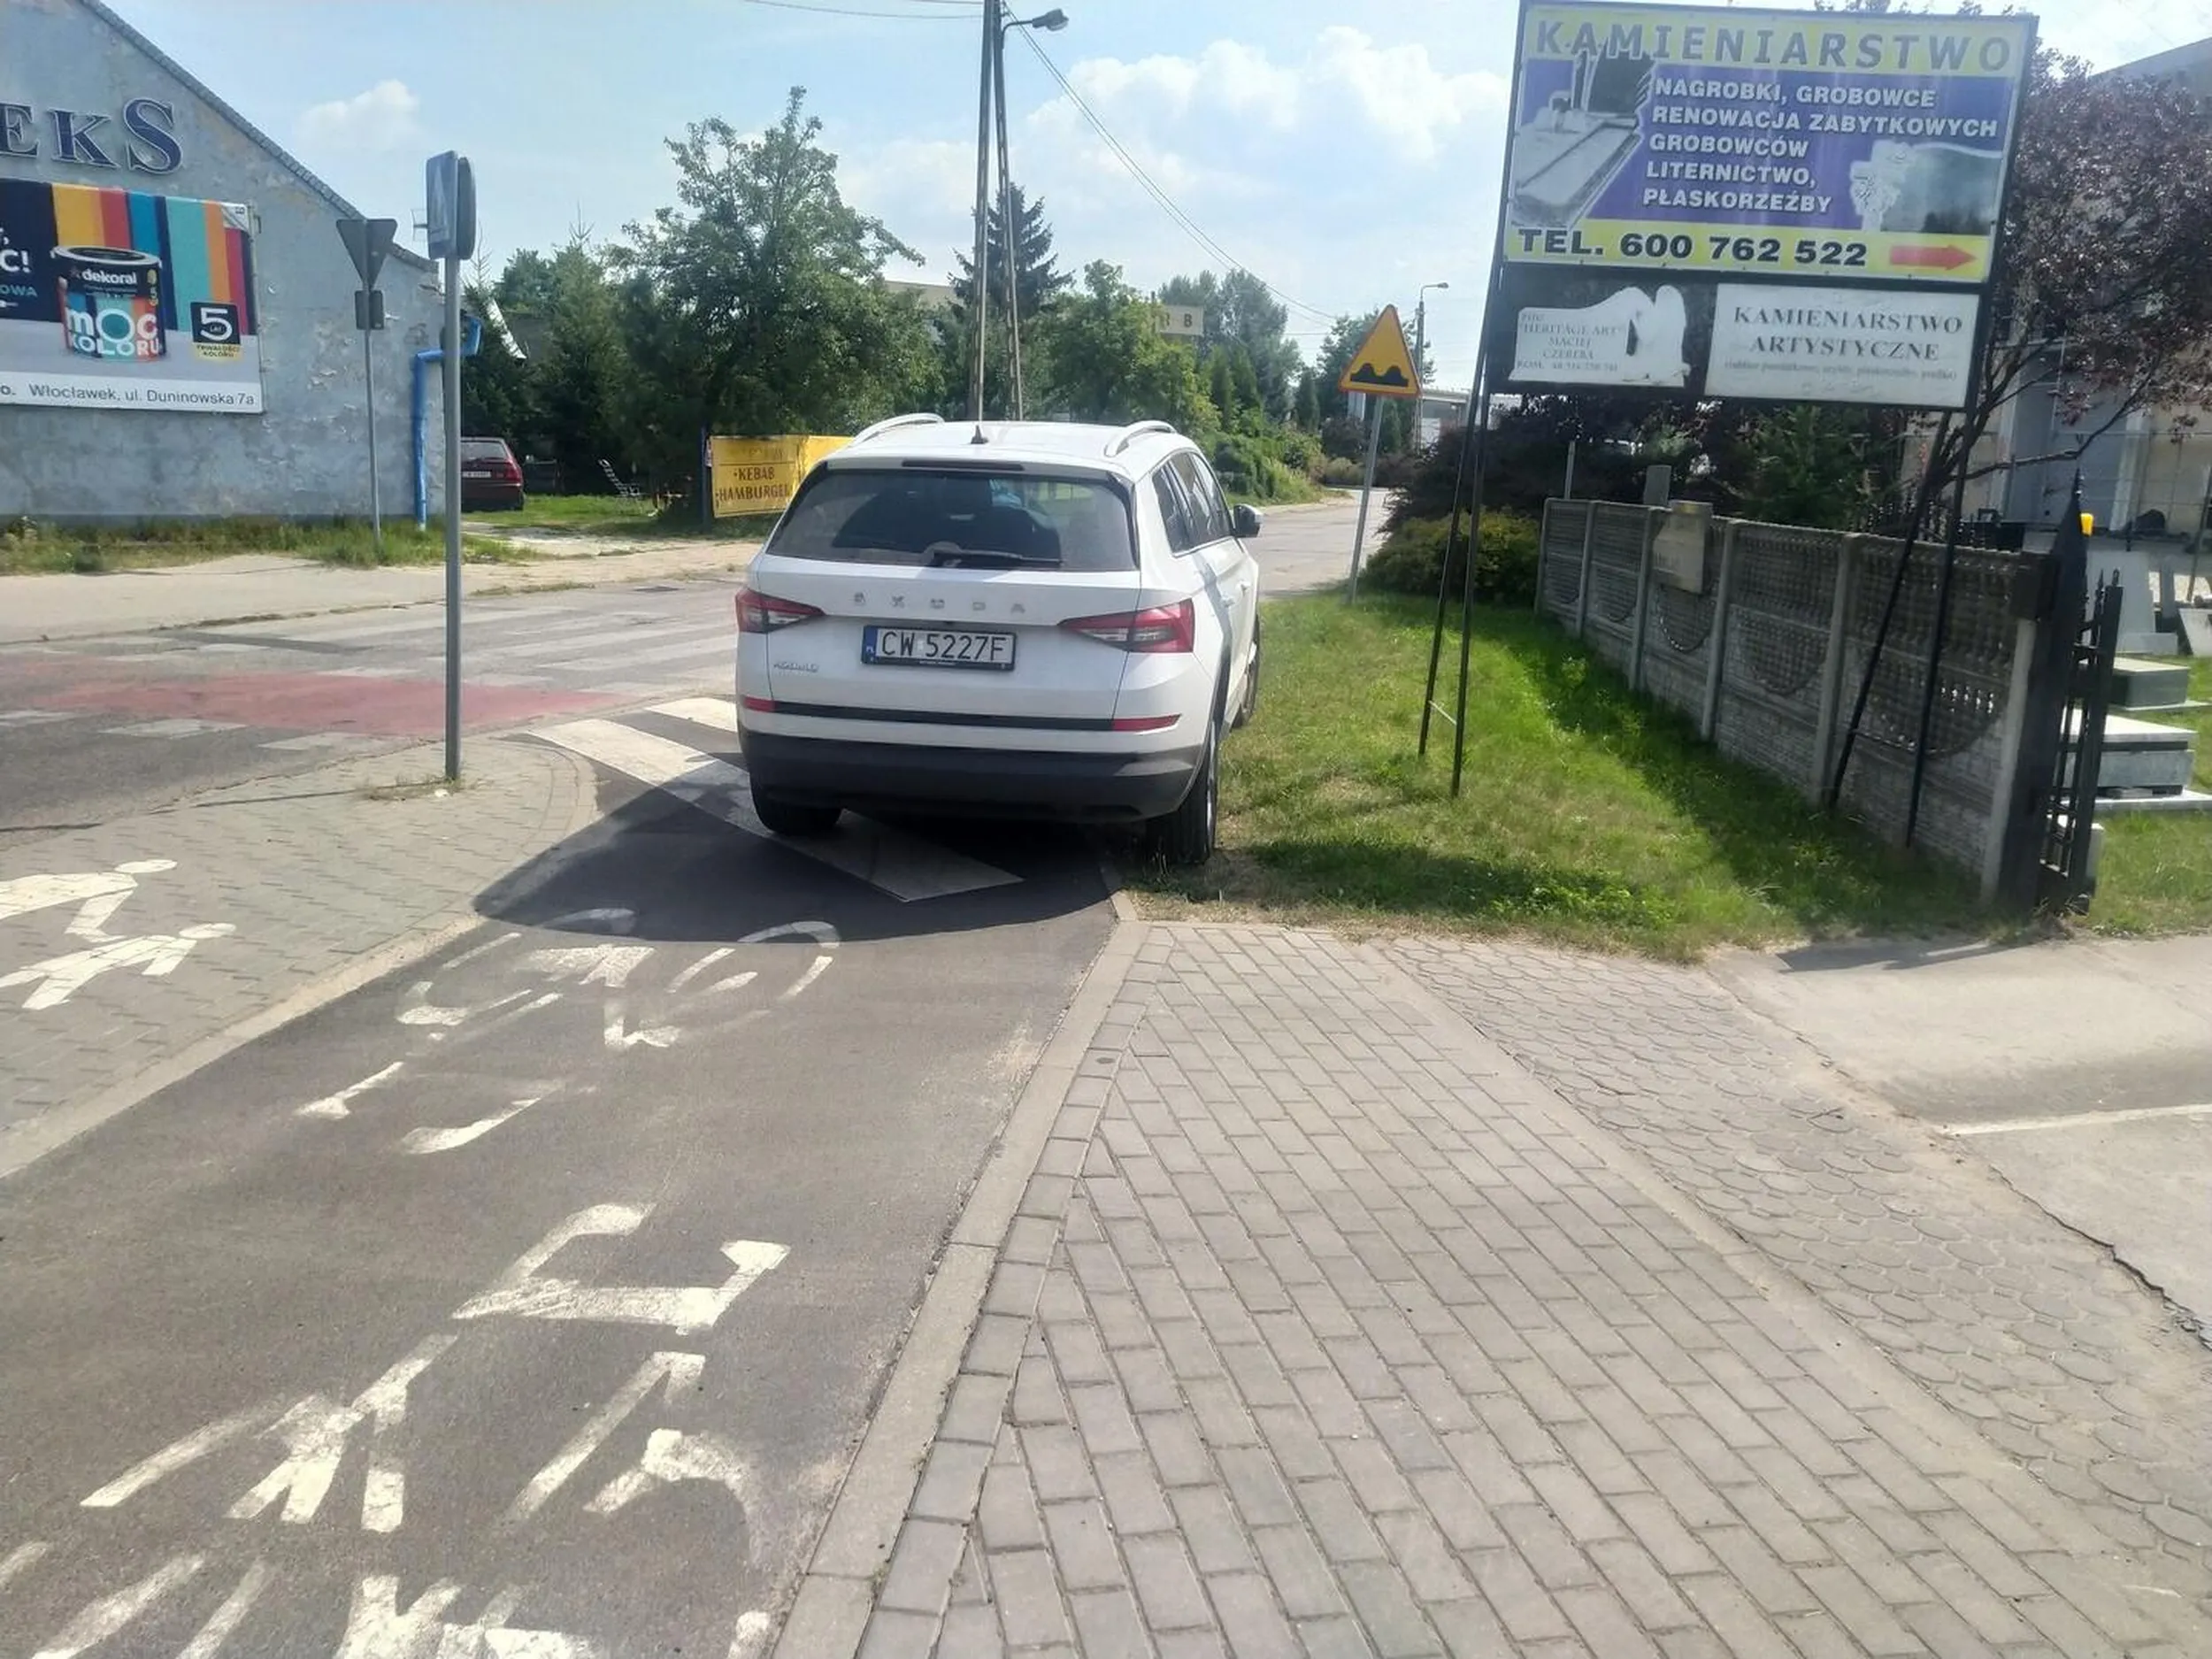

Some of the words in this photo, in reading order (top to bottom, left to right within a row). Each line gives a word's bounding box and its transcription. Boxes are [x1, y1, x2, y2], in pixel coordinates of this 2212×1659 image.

[1535, 19, 2011, 73] KAMIENIARSTWO
[1655, 77, 1787, 105] NAGROBKI,
[1796, 85, 1937, 109] GROBOWCE
[1651, 107, 1801, 132] RENOWACJA
[1808, 113, 1998, 137] ZABYTKOWYCH
[1648, 134, 1809, 159] GROBOWCÓW
[1646, 161, 1816, 188] LITERNICTWO,
[1517, 227, 1604, 256] TEL.
[1619, 233, 1693, 259] 600
[1708, 236, 1780, 263] 762
[1793, 239, 1868, 266] 522
[81, 268, 137, 285] dekoral
[200, 307, 233, 341] 5
[1733, 306, 1963, 334] KAMIENIARSTWO
[1749, 335, 1940, 361] ARTYSTYCZNE
[29, 383, 121, 401] Włocławek,
[147, 389, 234, 405] Duninowska
[237, 394, 254, 405] 7a
[881, 631, 915, 657] CW
[925, 633, 1007, 662] 5227F
